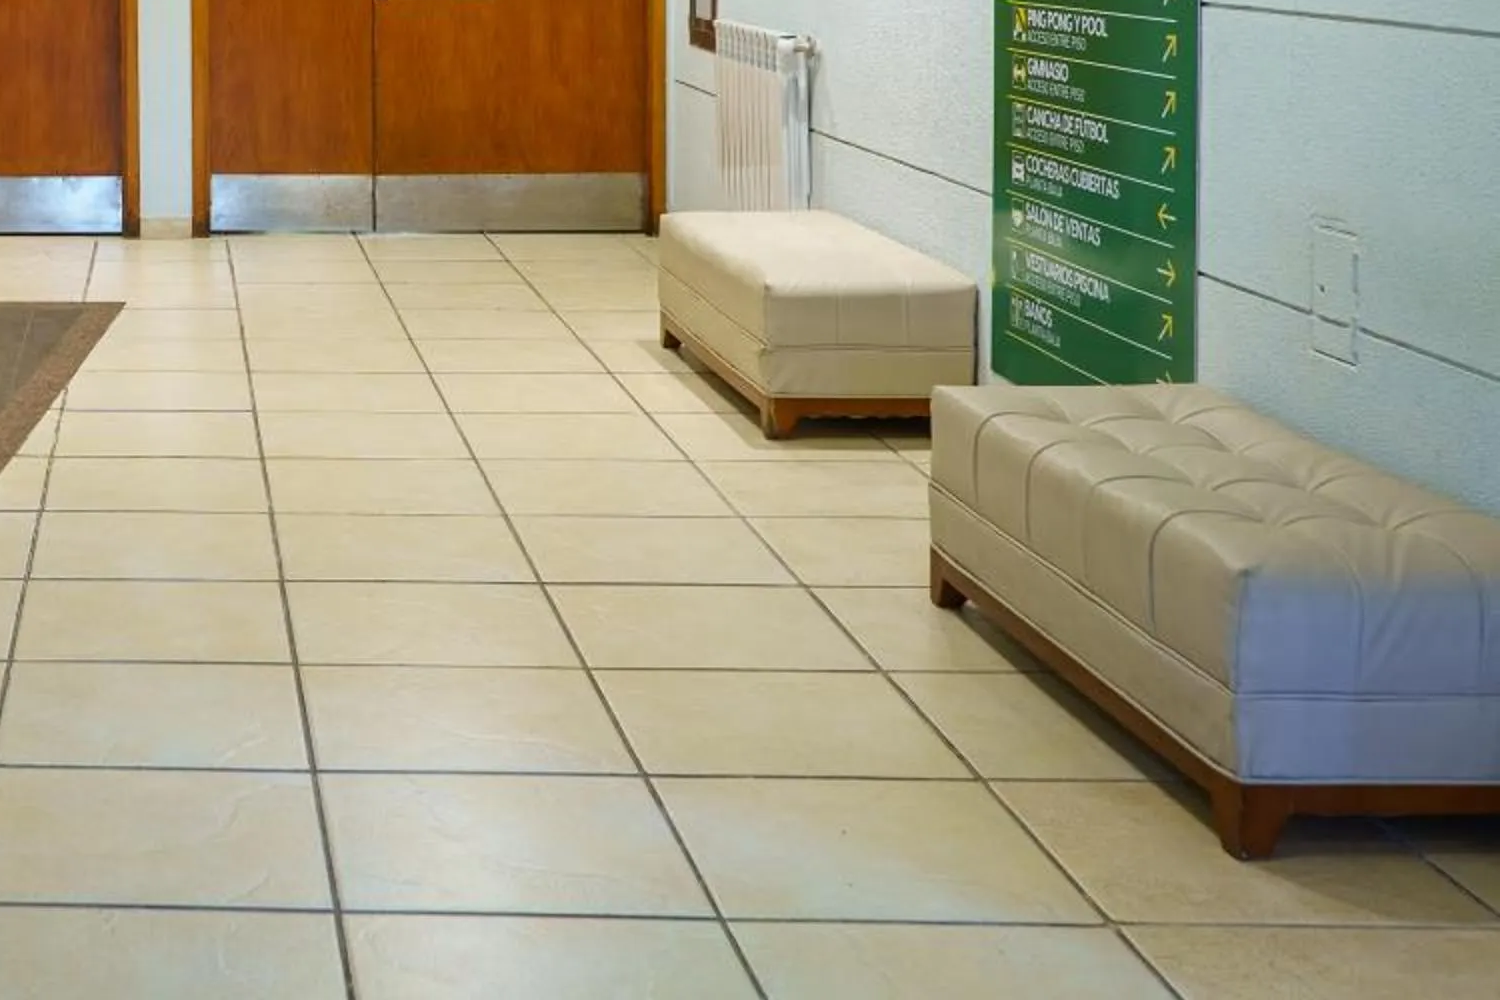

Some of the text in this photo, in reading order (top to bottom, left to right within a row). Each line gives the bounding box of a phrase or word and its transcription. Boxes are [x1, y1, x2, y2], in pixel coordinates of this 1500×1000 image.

[1048, 10, 1073, 32] PONG
[1074, 14, 1081, 33] Y
[1082, 15, 1108, 37] POOL
[1028, 57, 1069, 82] GIMNASIO
[1027, 105, 1062, 131] CANCHA
[1062, 114, 1073, 134] DE
[1026, 154, 1120, 199] COCHERAS CUBIERTAS
[1053, 211, 1063, 232] DE
[1065, 216, 1101, 247] VENTAS
